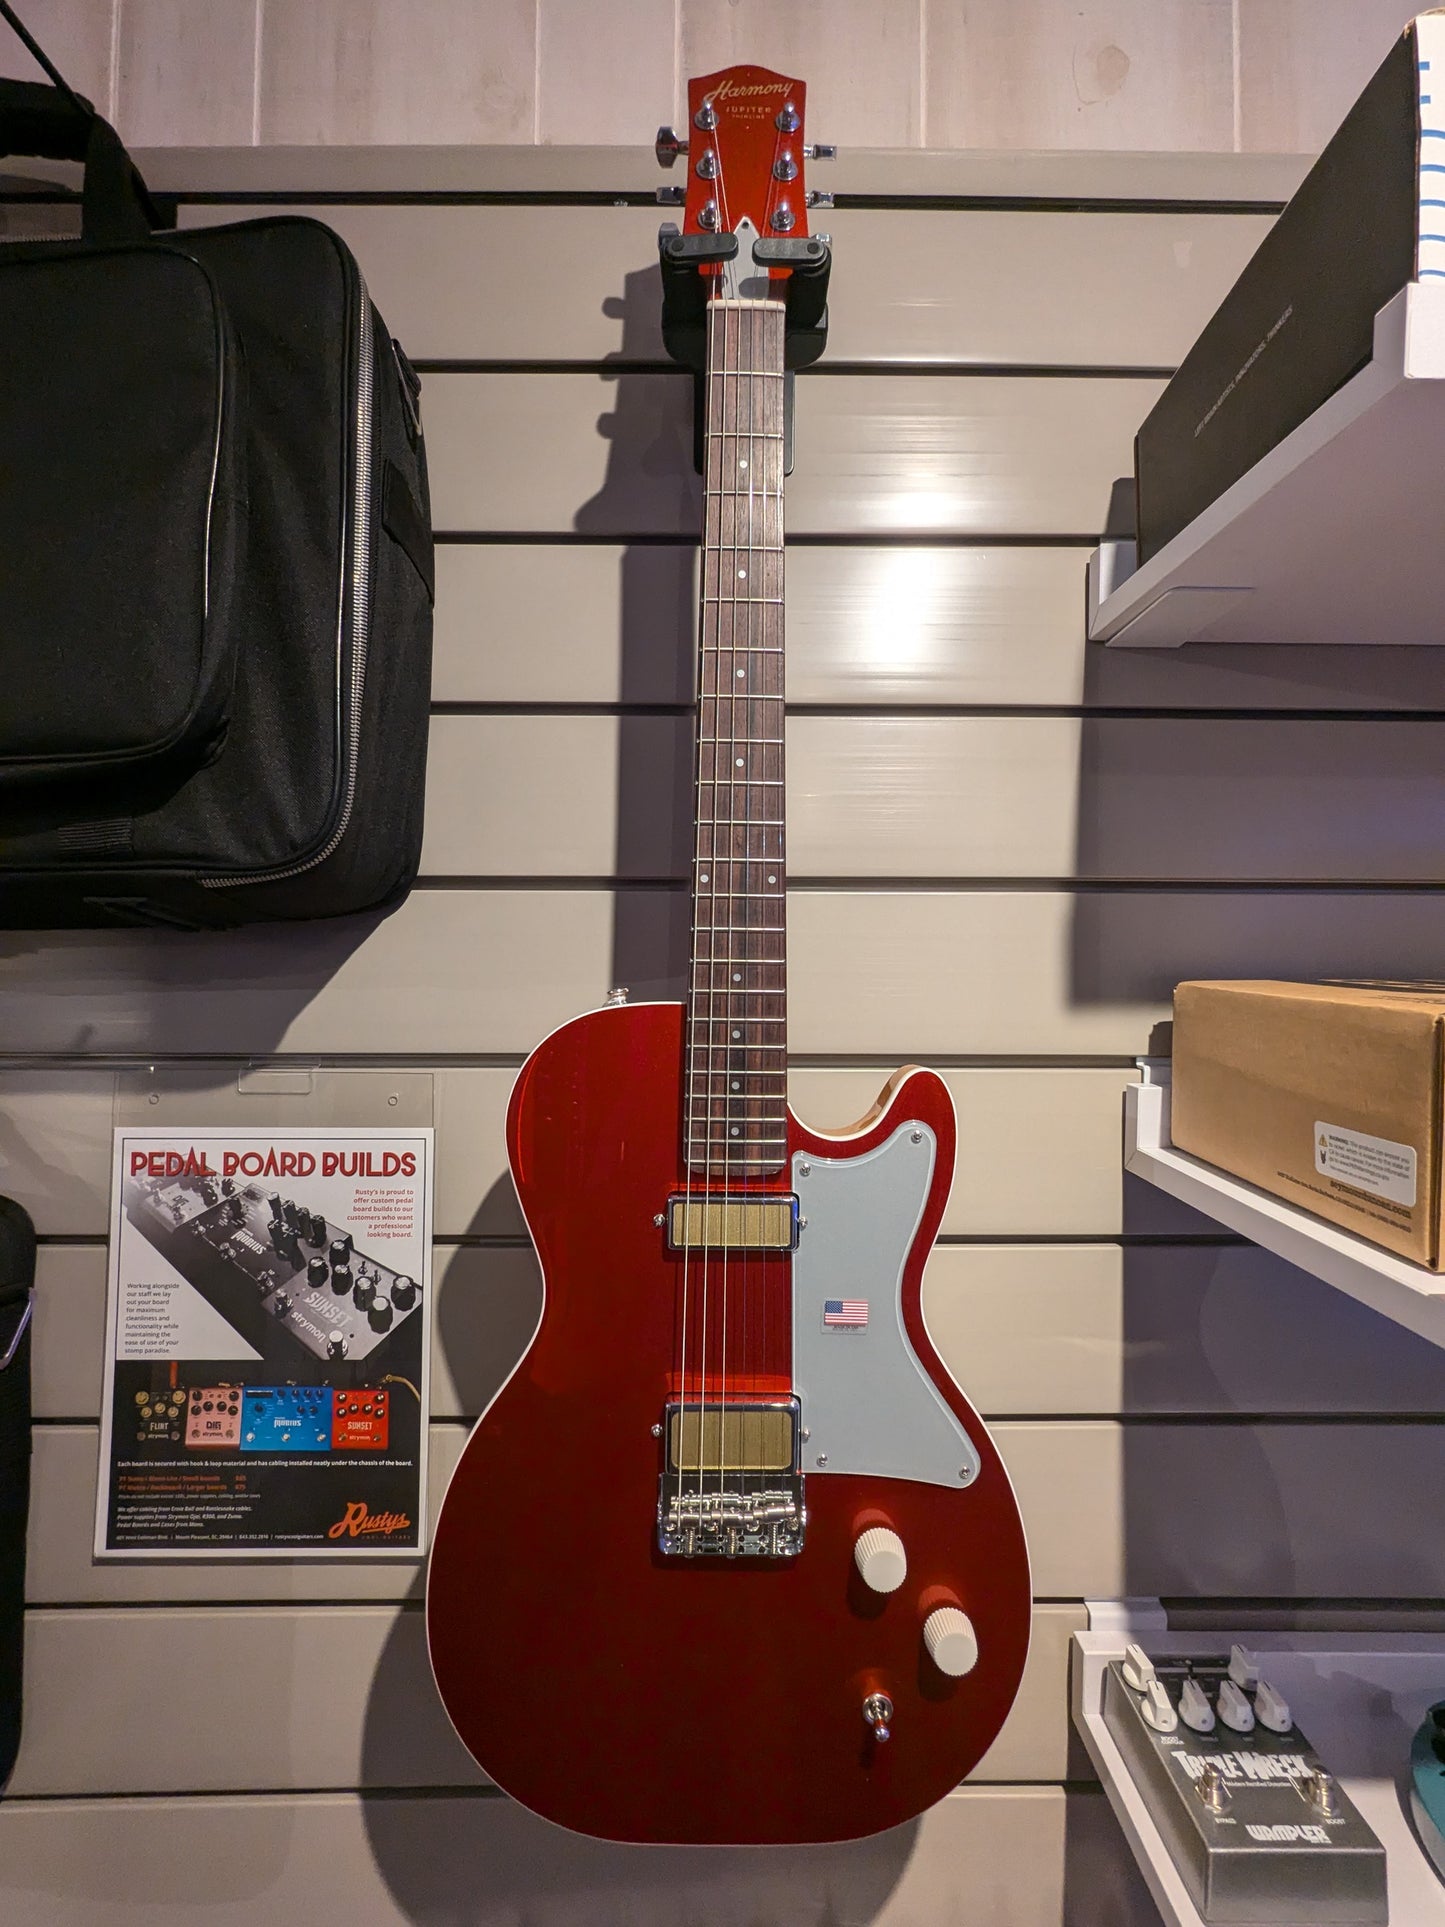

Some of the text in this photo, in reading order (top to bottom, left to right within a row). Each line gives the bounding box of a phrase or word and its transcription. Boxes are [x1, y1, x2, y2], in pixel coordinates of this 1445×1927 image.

[702, 80, 794, 101] Harmony
[130, 1146, 416, 1176] PEDAL BOARD BUILDS
[303, 1292, 353, 1327] SUNSET
[291, 1312, 327, 1342] strymon
[348, 1421, 373, 1430] SUNSET
[313, 1460, 330, 1468] neatly
[328, 1502, 411, 1539] Rustys
[1231, 1750, 1315, 1780] WRECK
[1245, 1824, 1331, 1843] WAMPLER
